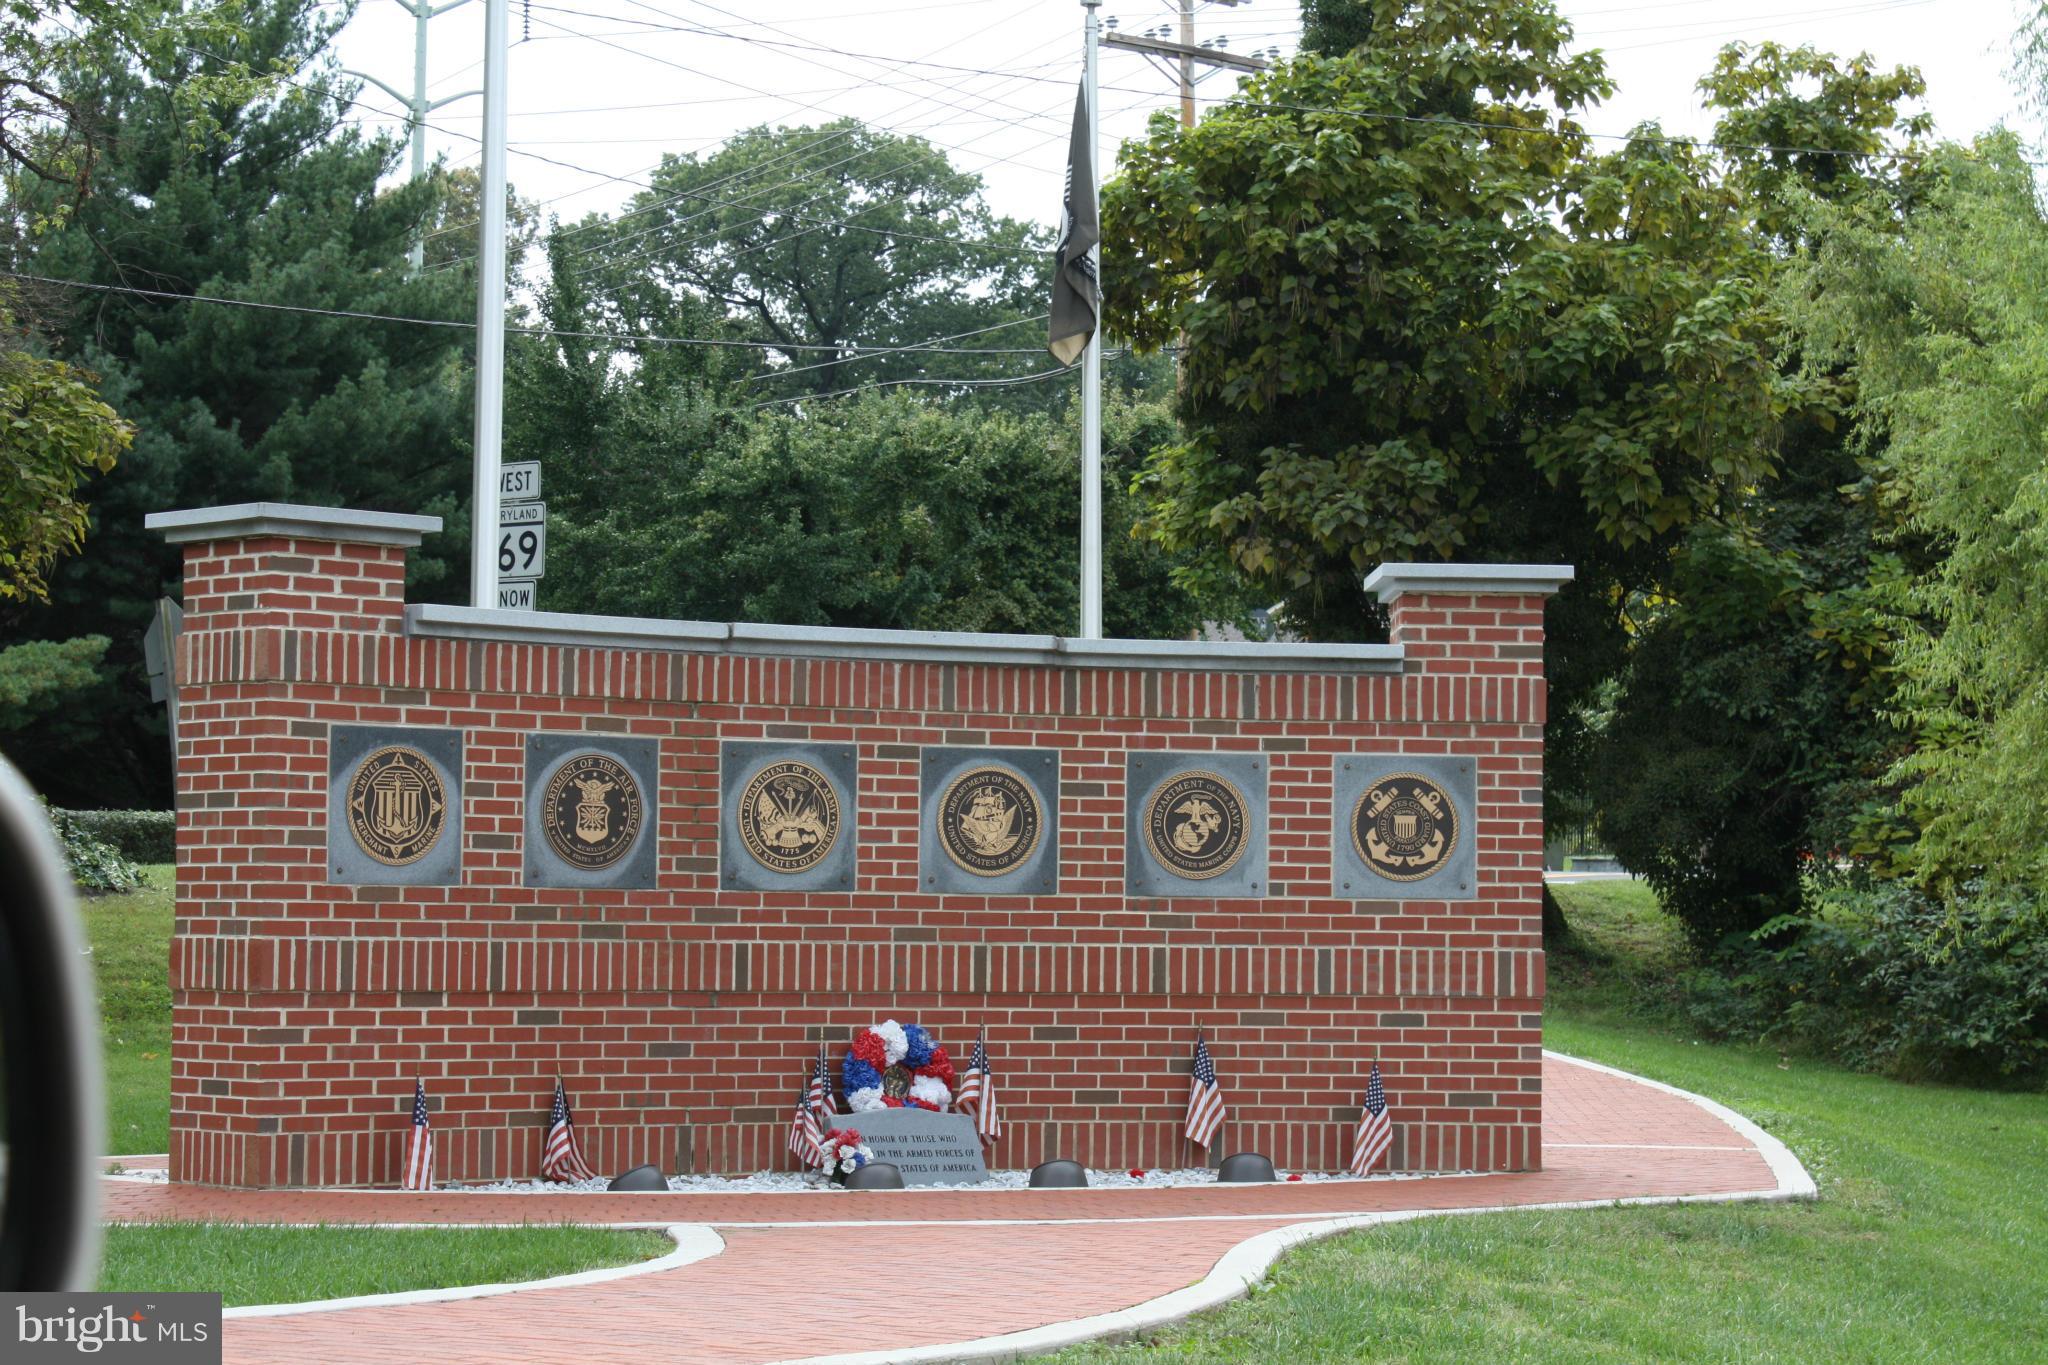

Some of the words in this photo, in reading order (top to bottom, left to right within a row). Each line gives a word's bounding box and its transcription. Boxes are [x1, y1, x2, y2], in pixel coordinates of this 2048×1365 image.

[356, 760, 380, 792] UNITED
[414, 762, 438, 792] STATES
[744, 765, 787, 809] DEPARTMENT
[792, 766, 804, 775] OF
[807, 771, 823, 786] THE
[823, 788, 838, 816] ARMY
[948, 775, 990, 813] DEPARTMENT
[992, 775, 1004, 784] OF
[1004, 779, 1019, 793] THE
[1018, 793, 1033, 813] NAVY
[545, 764, 576, 826] DEPARTMENT
[580, 759, 594, 768] OF
[599, 760, 617, 774] THE
[619, 774, 634, 793] AIR
[630, 798, 639, 835] FORCE
[1153, 780, 1205, 827] DEPARTMENT
[1206, 784, 1217, 792] OF
[1228, 800, 1241, 830] NAVY
[1382, 800, 1408, 818] STATES
[1408, 801, 1430, 820] COAST
[355, 819, 388, 855] MERCHANT
[412, 827, 437, 853] MARINE
[743, 819, 762, 854] UNITED
[763, 852, 798, 868] STATES
[800, 857, 812, 867] OF
[812, 821, 837, 860] AMERICA
[947, 825, 967, 855] UNITED
[966, 853, 997, 867] STATES
[998, 855, 1010, 865] OF
[1010, 825, 1033, 859] AMERICA
[1156, 834, 1173, 857] UNITED
[1173, 855, 1198, 868] STATES
[1199, 855, 1224, 868] MARINE
[1380, 821, 1396, 850] UNITED
[1415, 822, 1431, 848] GUARD
